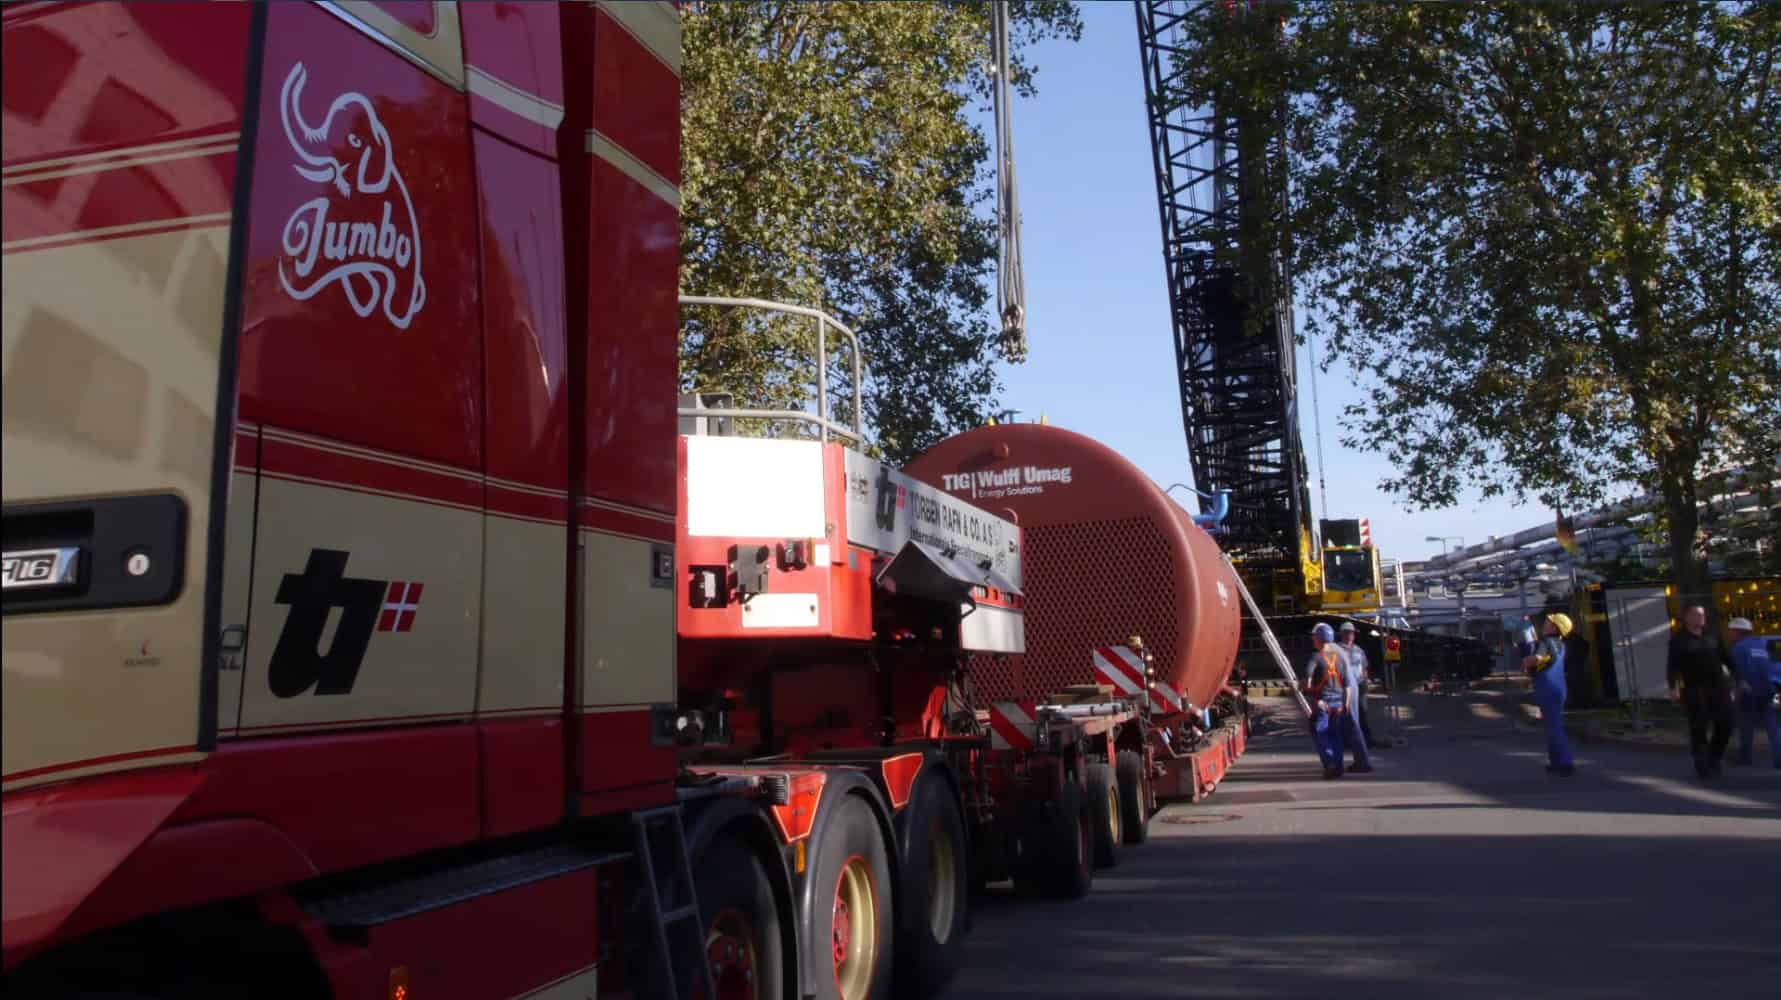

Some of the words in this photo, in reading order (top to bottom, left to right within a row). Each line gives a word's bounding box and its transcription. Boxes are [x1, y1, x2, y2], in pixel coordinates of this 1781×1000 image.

[283, 197, 411, 276] Jumbo
[943, 473, 971, 491] TIG
[978, 467, 1020, 487] Wulff
[1023, 465, 1072, 484] Umag
[909, 490, 940, 527] TORBEN
[942, 503, 961, 536] RAFN
